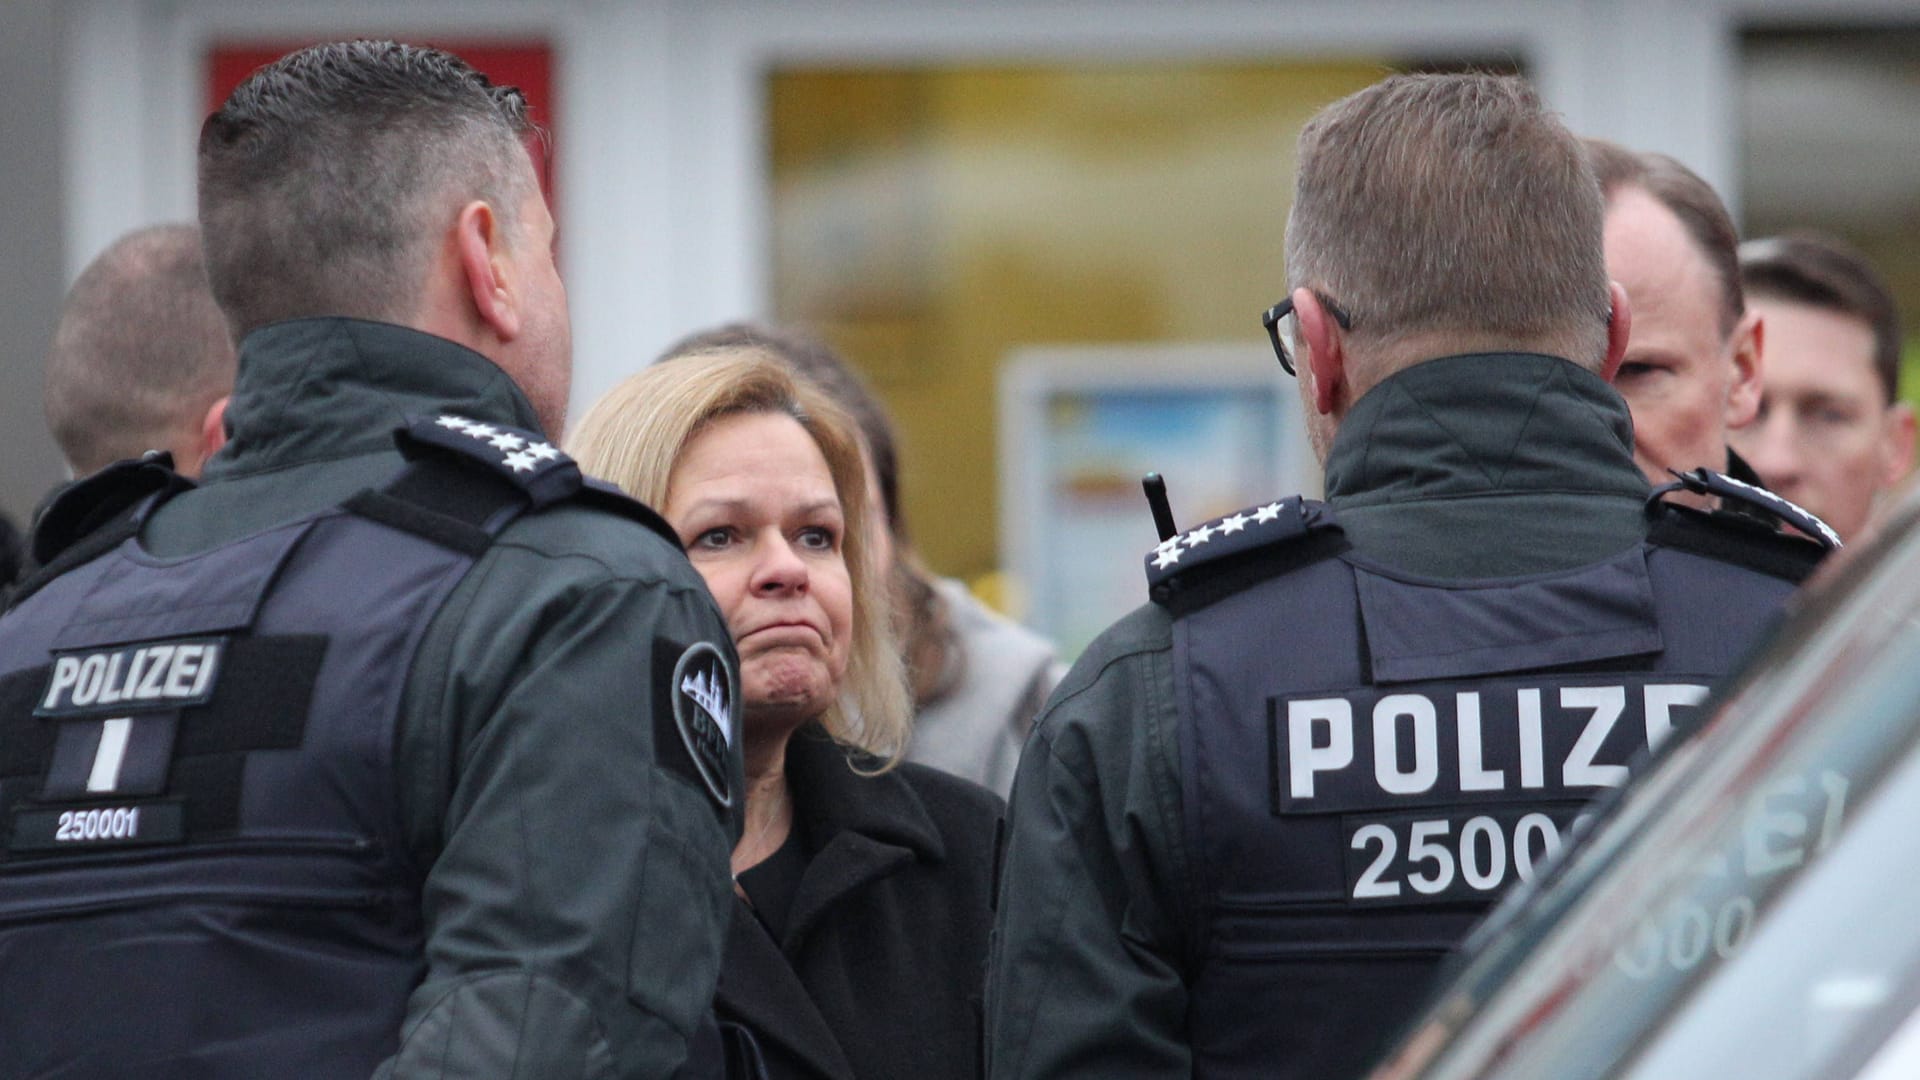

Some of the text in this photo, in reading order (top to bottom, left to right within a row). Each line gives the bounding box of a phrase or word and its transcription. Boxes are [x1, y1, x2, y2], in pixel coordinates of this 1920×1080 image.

[43, 645, 218, 708] POLIZEI
[56, 807, 139, 840] 250001
[1351, 813, 1594, 898] 2500
